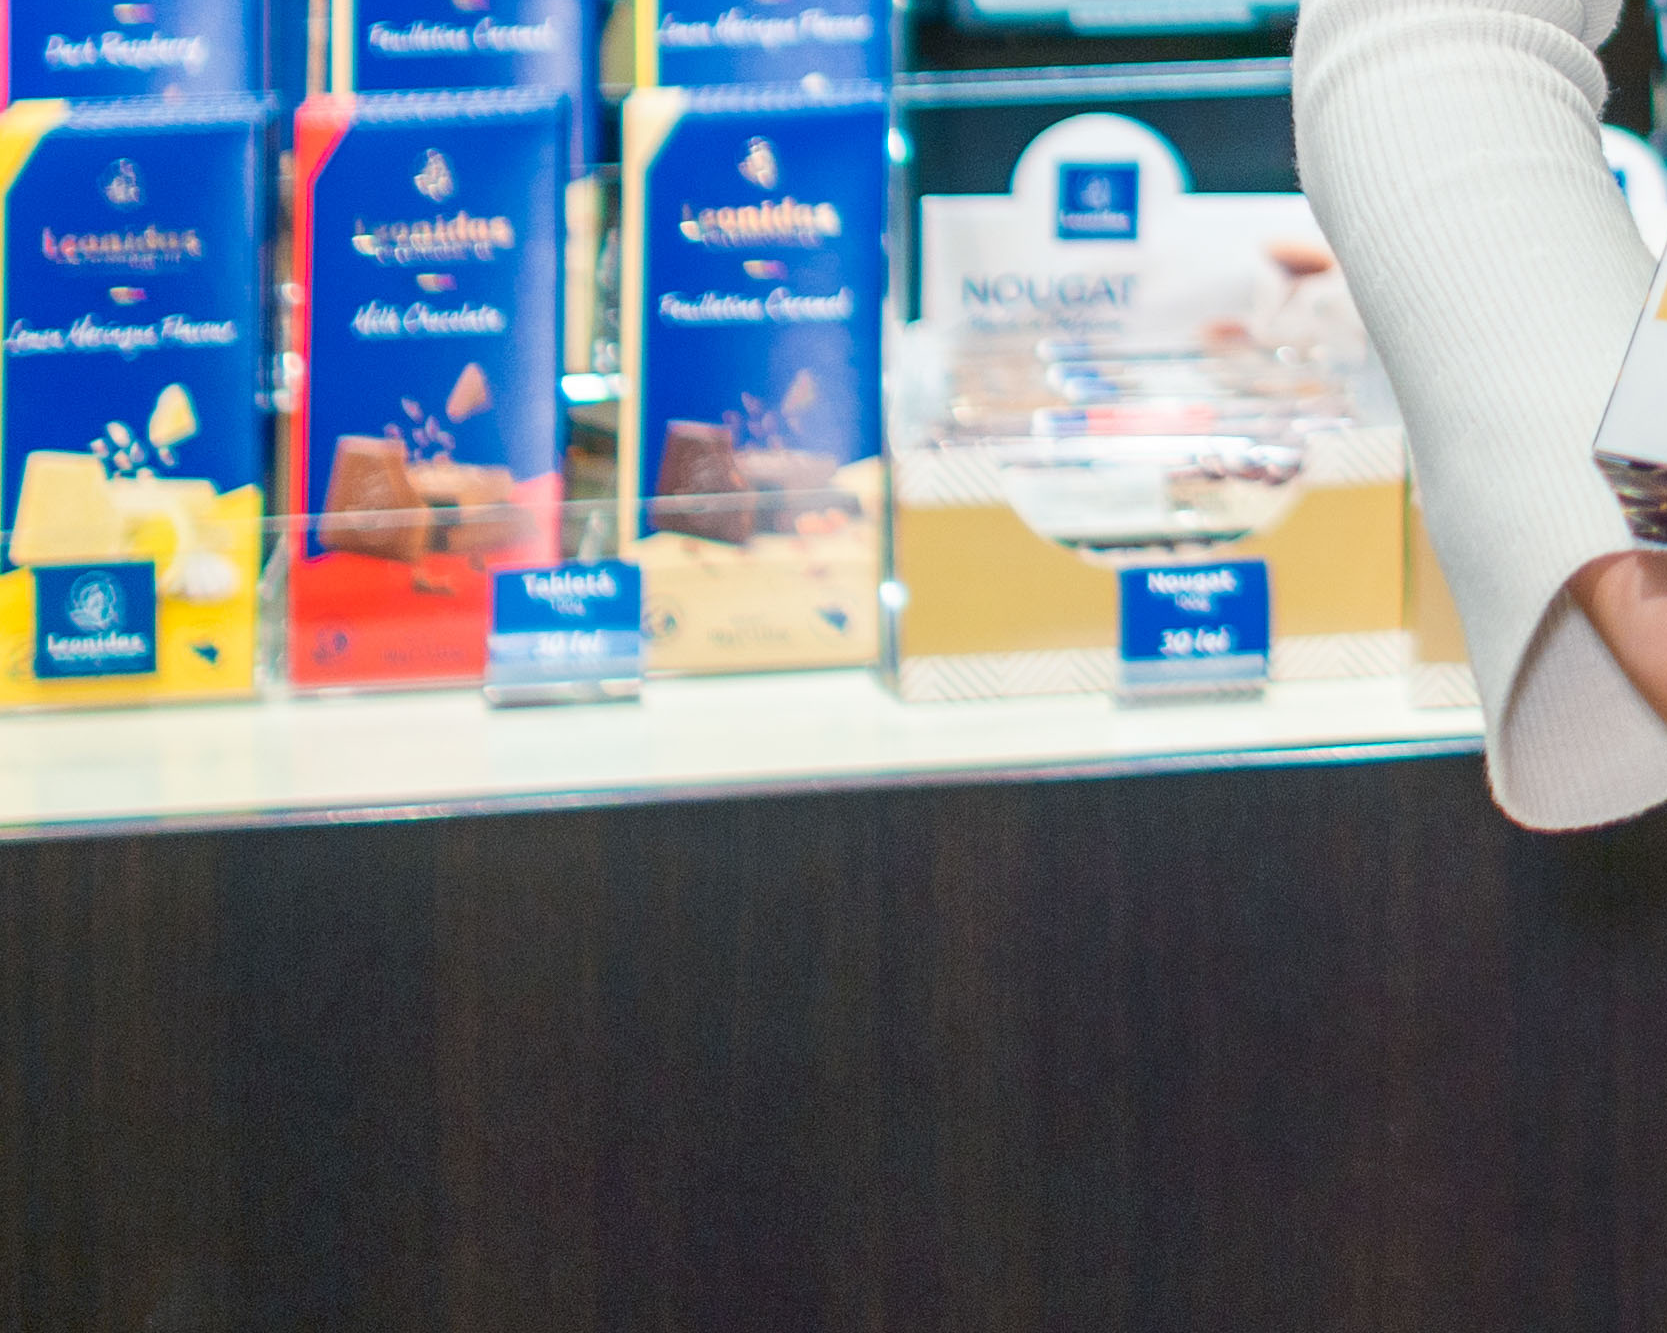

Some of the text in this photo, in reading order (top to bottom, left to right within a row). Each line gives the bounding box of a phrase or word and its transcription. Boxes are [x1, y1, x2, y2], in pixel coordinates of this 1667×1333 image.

[352, 211, 514, 255] Leonidas
[680, 197, 841, 242] Leonidas
[42, 226, 202, 259] Leonidas
[765, 287, 852, 322] Caramel
[961, 273, 1139, 309] NOUGAT
[353, 300, 507, 334] Milk Chocolate
[1147, 569, 1237, 595] Nougat
[46, 631, 146, 654] Leonidas
[1159, 627, 1231, 655] 30 lei
